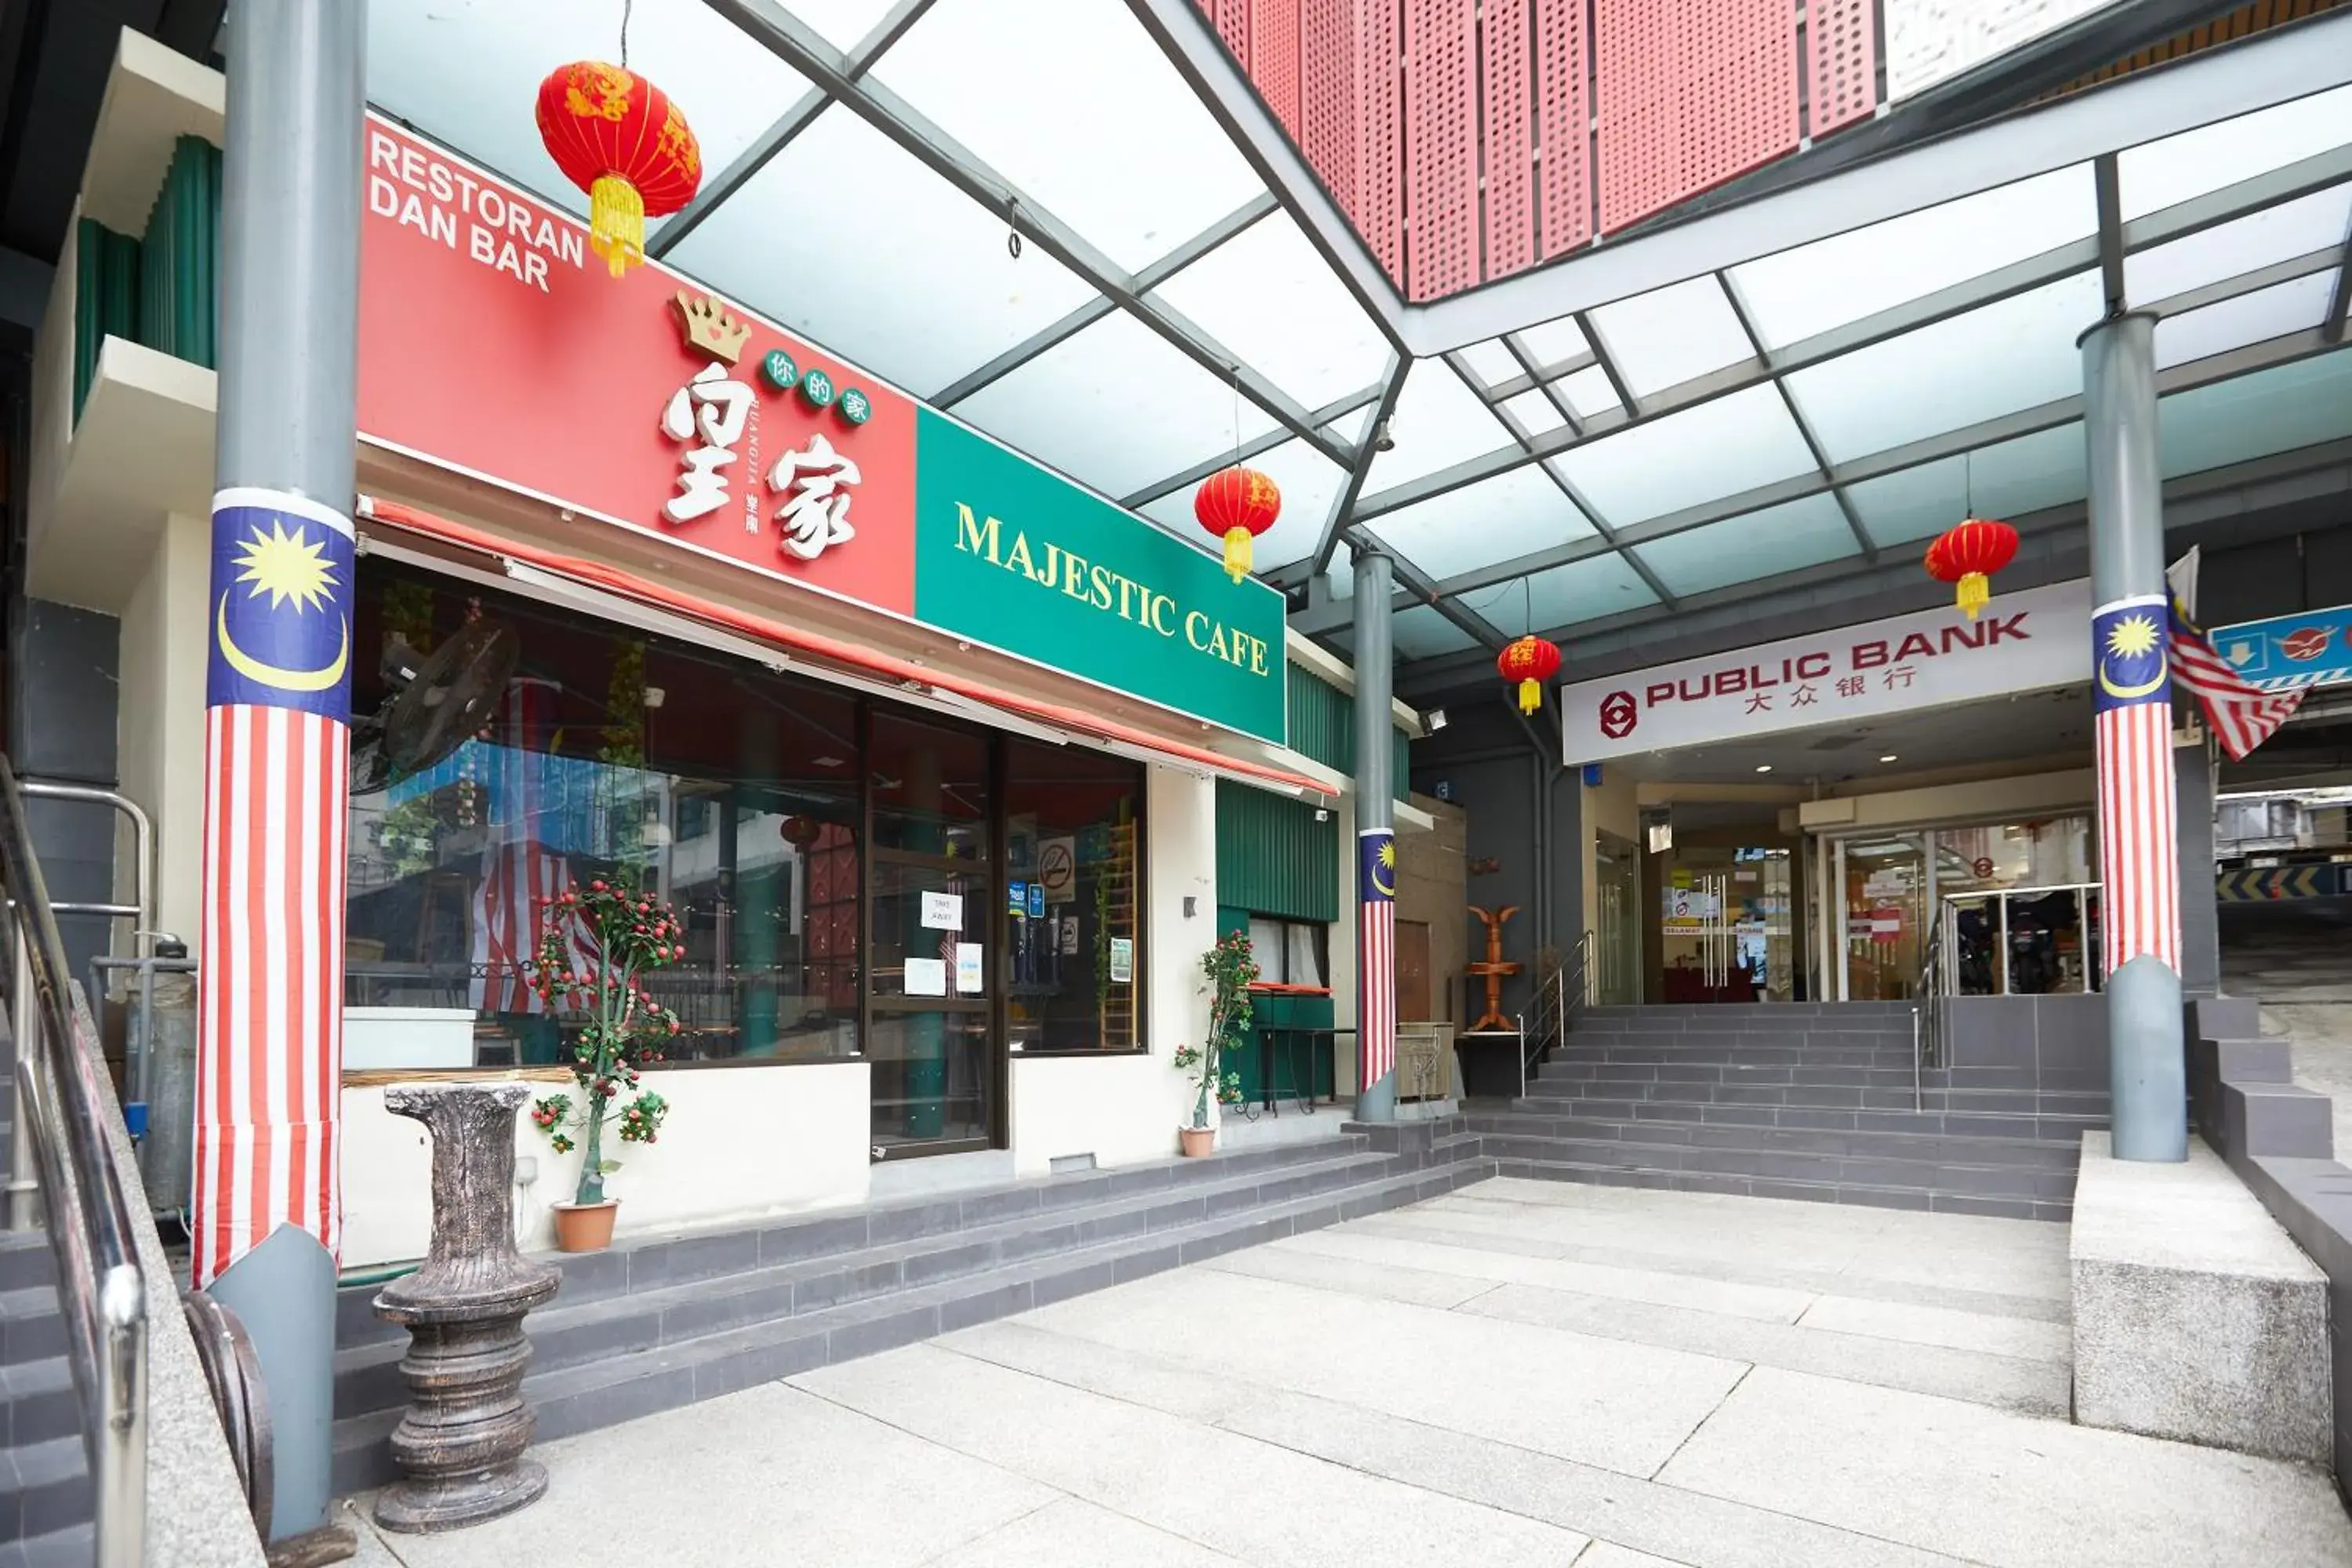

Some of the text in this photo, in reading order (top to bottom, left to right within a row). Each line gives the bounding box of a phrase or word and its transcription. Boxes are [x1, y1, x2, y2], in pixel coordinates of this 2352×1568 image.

[369, 174, 550, 294] DAN BAR
[370, 130, 583, 270] RESTORAN
[770, 353, 866, 421] 你的家
[662, 361, 862, 561] 皇家
[953, 500, 1270, 677] MAJESTIC CAFE
[1646, 611, 2033, 709] PUBLIC BANK
[1744, 666, 1916, 715] 大众银行
